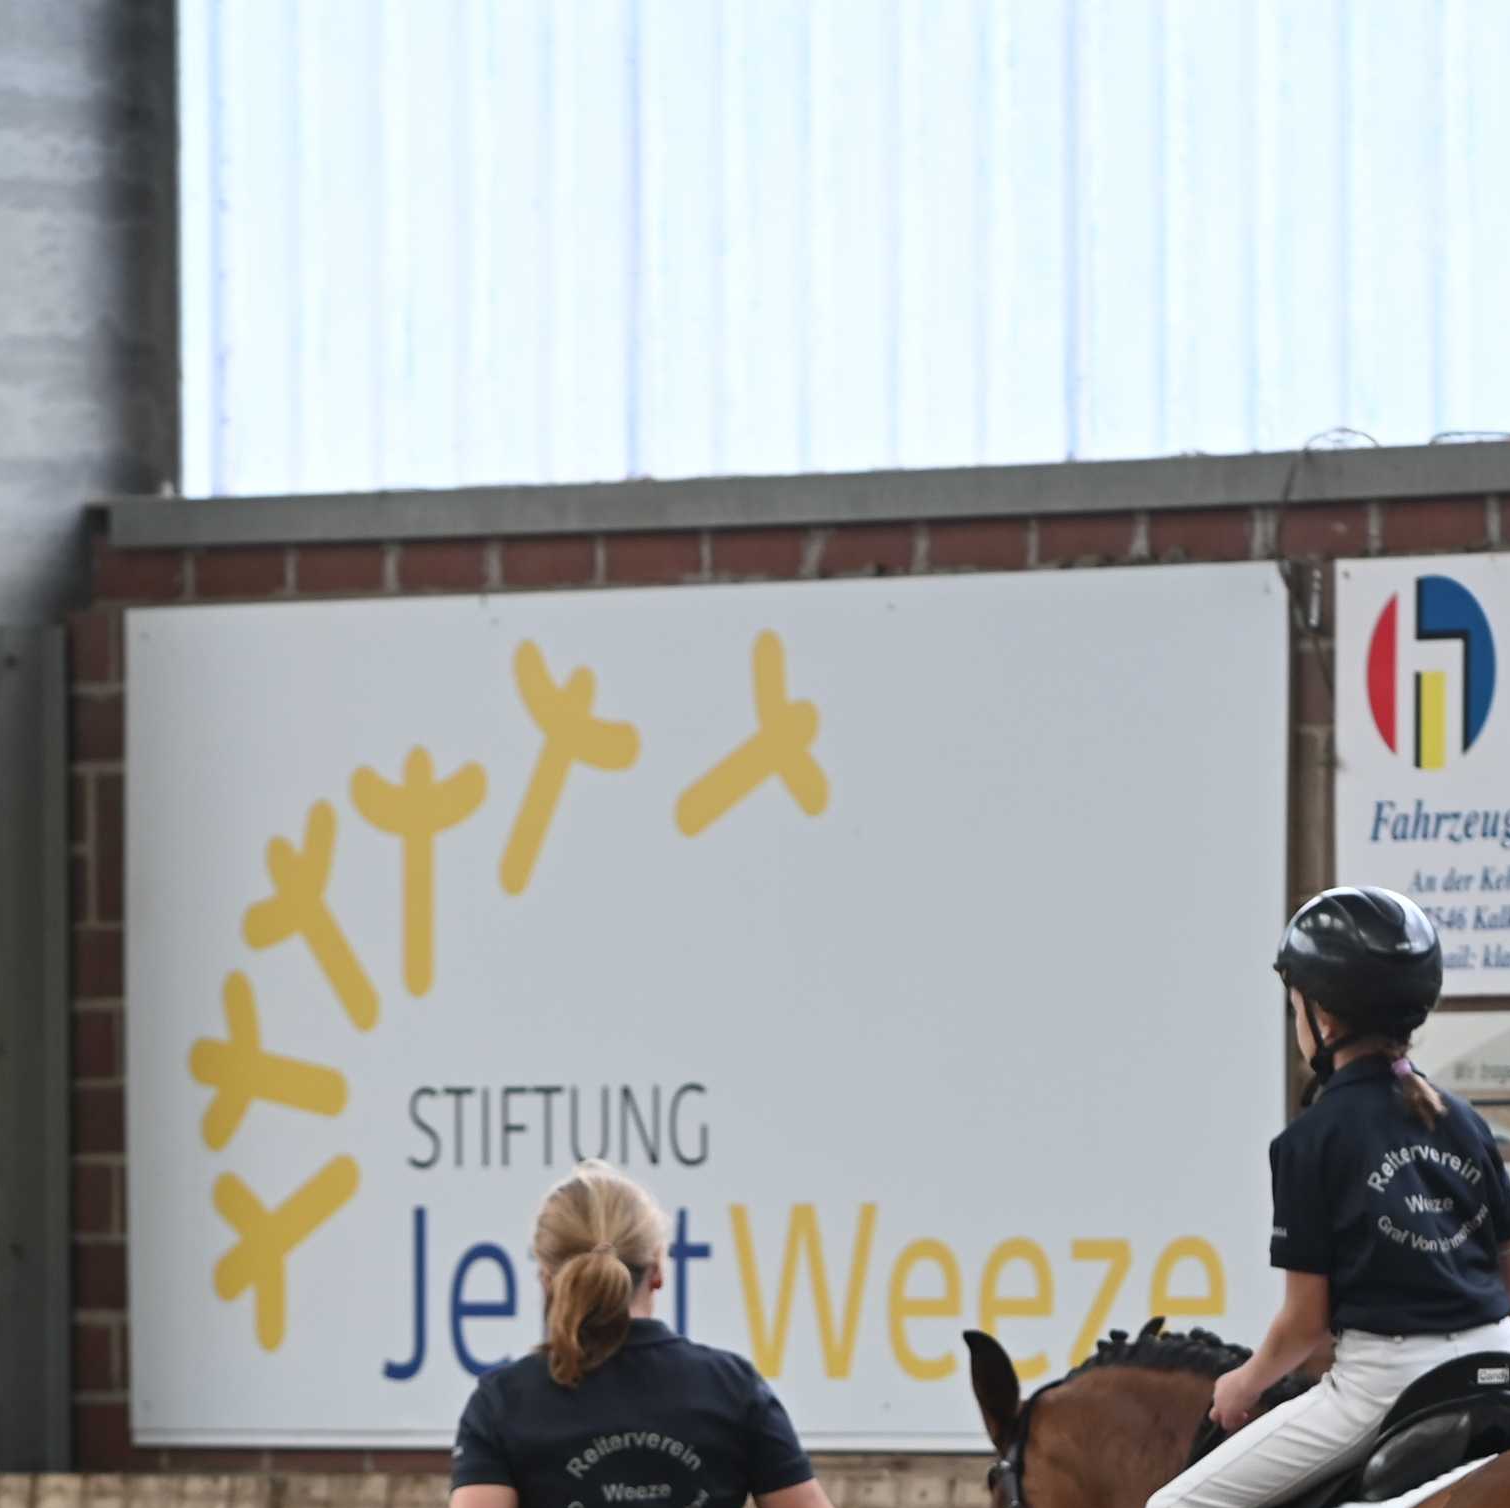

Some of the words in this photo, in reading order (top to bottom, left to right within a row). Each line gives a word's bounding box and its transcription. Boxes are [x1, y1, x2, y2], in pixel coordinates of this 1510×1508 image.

[1442, 868, 1474, 893] der
[406, 1081, 710, 1171] STIFTUNG
[1366, 1143, 1484, 1194] Reiterverein
[565, 1431, 702, 1480] Reiterverein
[602, 1482, 673, 1502] Weeze
